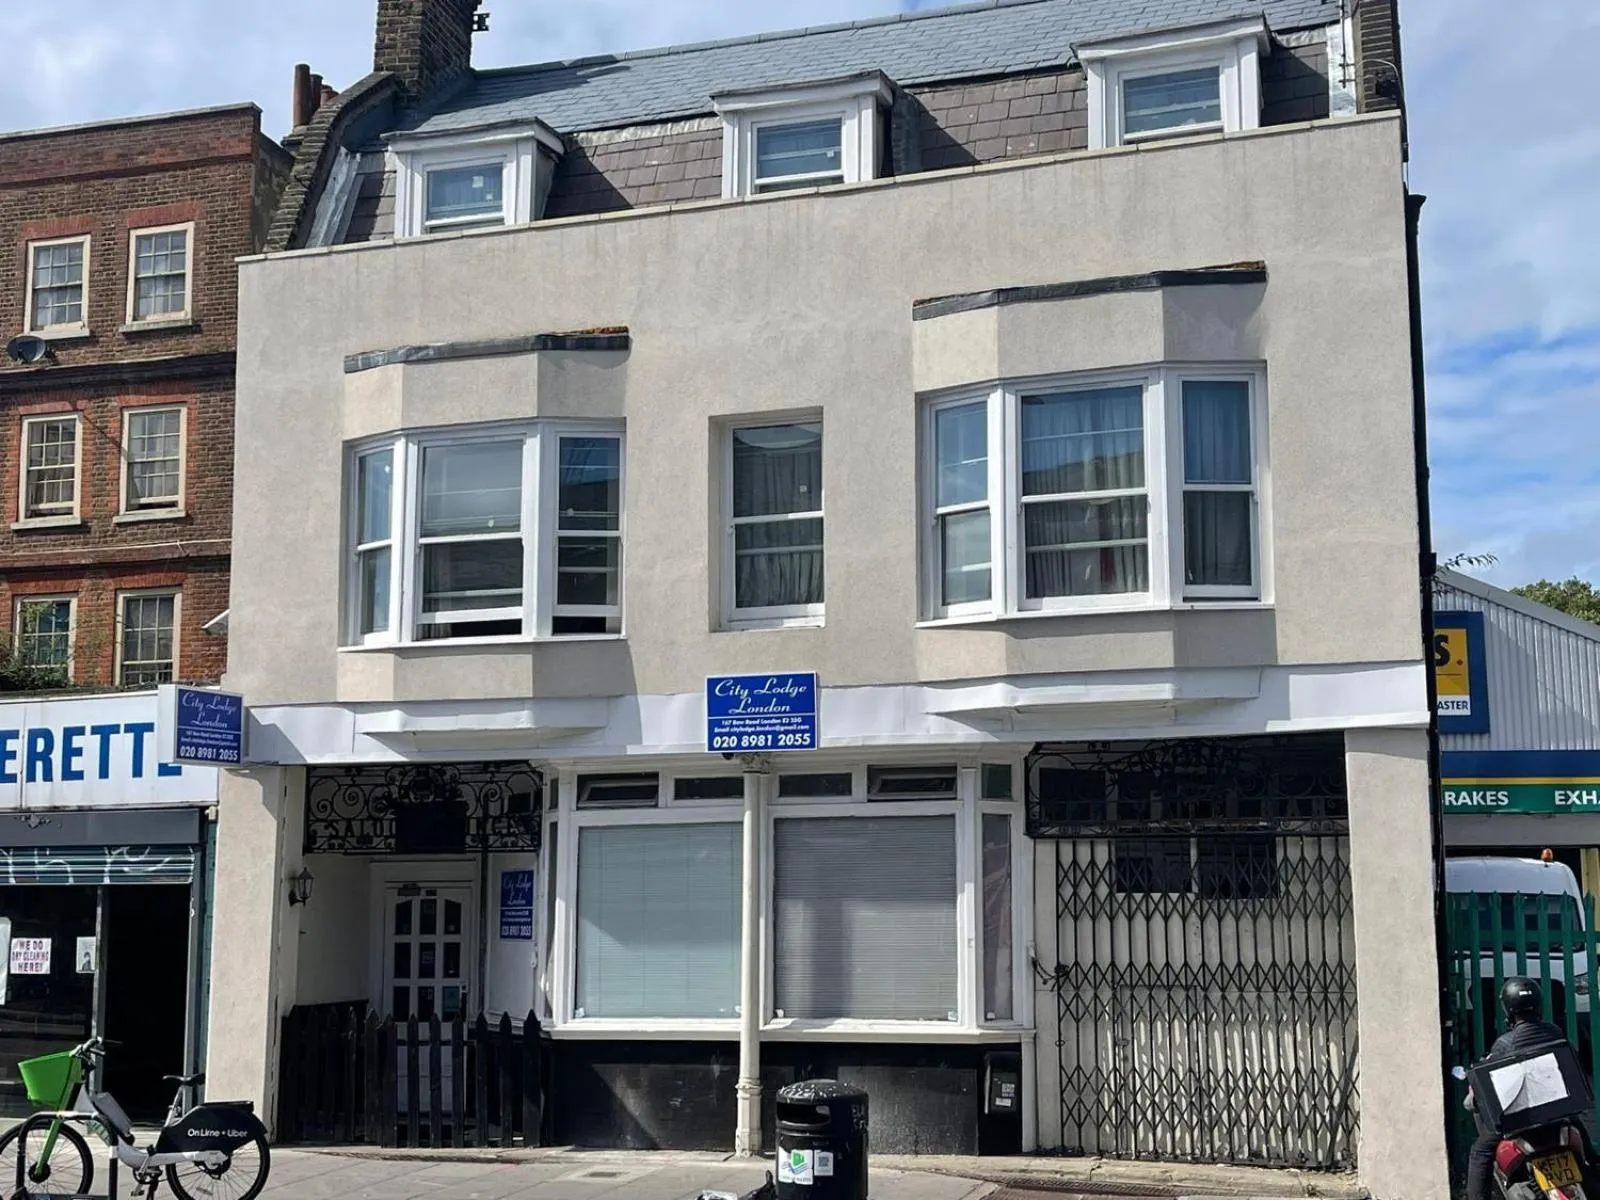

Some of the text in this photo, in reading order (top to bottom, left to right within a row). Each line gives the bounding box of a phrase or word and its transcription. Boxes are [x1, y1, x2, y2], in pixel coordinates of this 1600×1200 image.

[715, 677, 807, 700] City Lodge
[182, 692, 238, 716] City Lodge
[728, 698, 790, 714] London
[1438, 700, 1469, 711] ASTER
[191, 711, 228, 728] London
[713, 733, 811, 749] 020 8981 2055
[180, 746, 238, 761] 020 8981 2055
[1444, 790, 1510, 806] RAKES
[1554, 790, 1600, 805] EXH
[33, 940, 43, 950] DO
[227, 1128, 248, 1137] Uber
